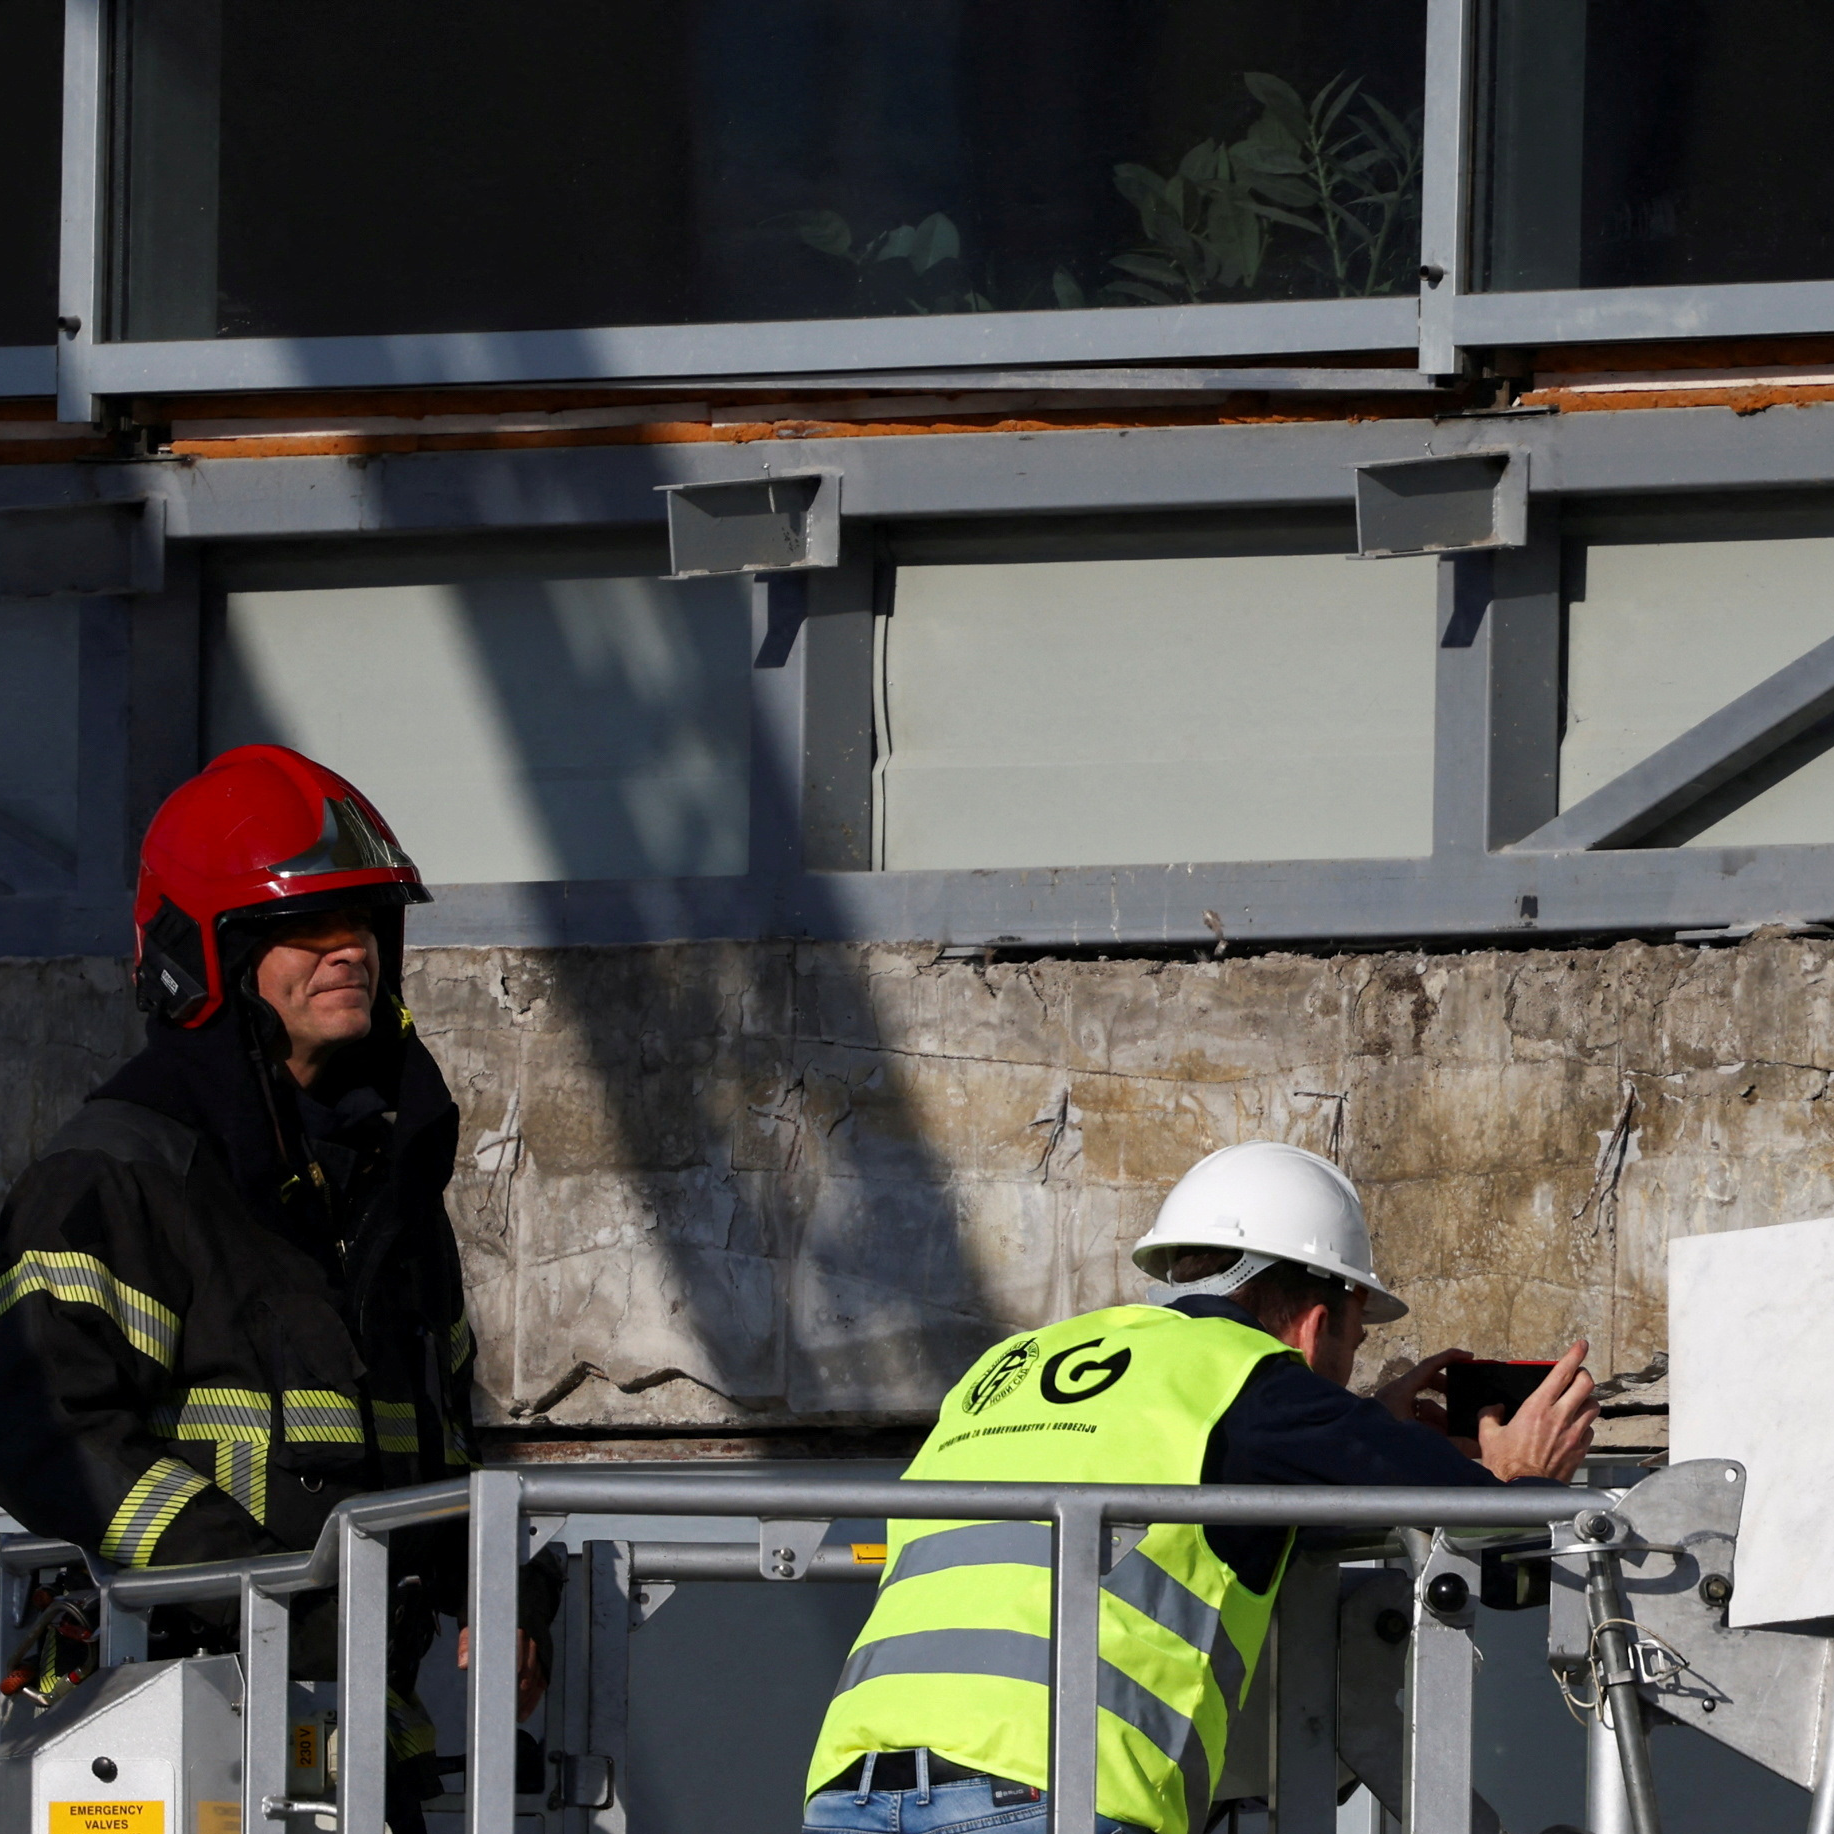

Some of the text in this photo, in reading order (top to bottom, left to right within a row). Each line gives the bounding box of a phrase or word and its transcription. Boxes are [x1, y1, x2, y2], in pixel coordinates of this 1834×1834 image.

[989, 1385, 1013, 1405] НОВИ
[1013, 1368, 1030, 1386] САД
[1052, 1422, 1097, 1433] GEODEZIJU
[300, 1728, 312, 1765] 230 V
[70, 1805, 143, 1816] EMERGENCY
[85, 1819, 129, 1829] VALVES
